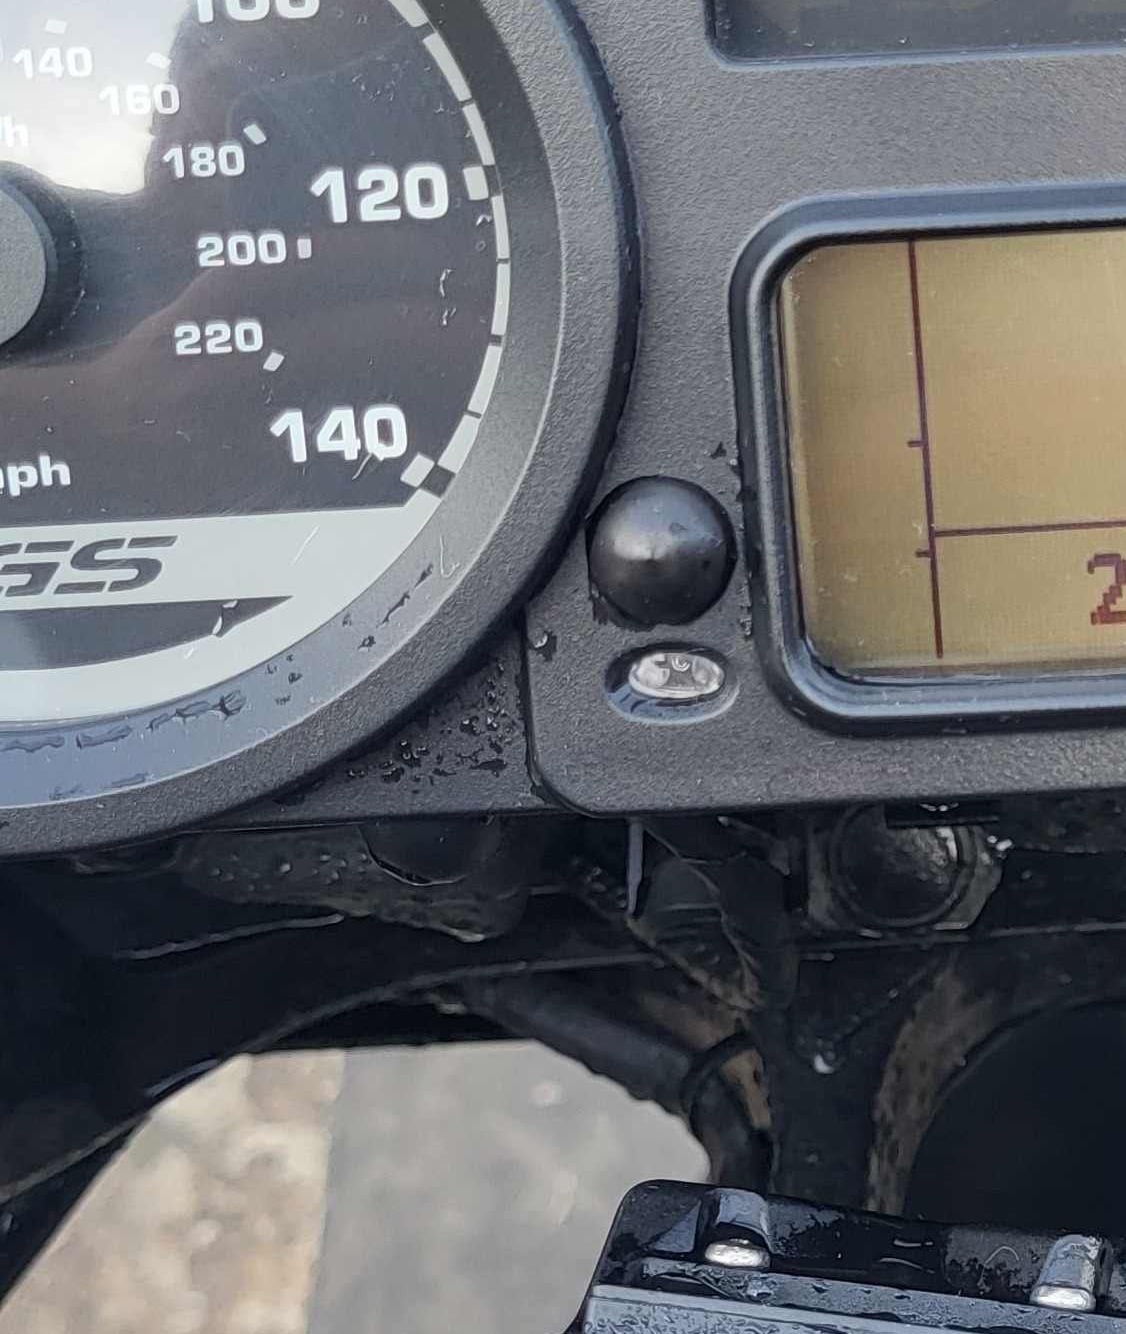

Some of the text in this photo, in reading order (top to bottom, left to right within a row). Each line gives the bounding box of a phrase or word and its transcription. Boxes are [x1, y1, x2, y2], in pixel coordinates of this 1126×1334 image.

[13, 47, 93, 79] 140
[98, 83, 180, 115] 160
[162, 144, 245, 178] 180
[309, 165, 449, 223] 120
[197, 230, 287, 267] 200
[174, 319, 263, 355] 220
[270, 404, 408, 463] 140
[0, 454, 71, 497] ph
